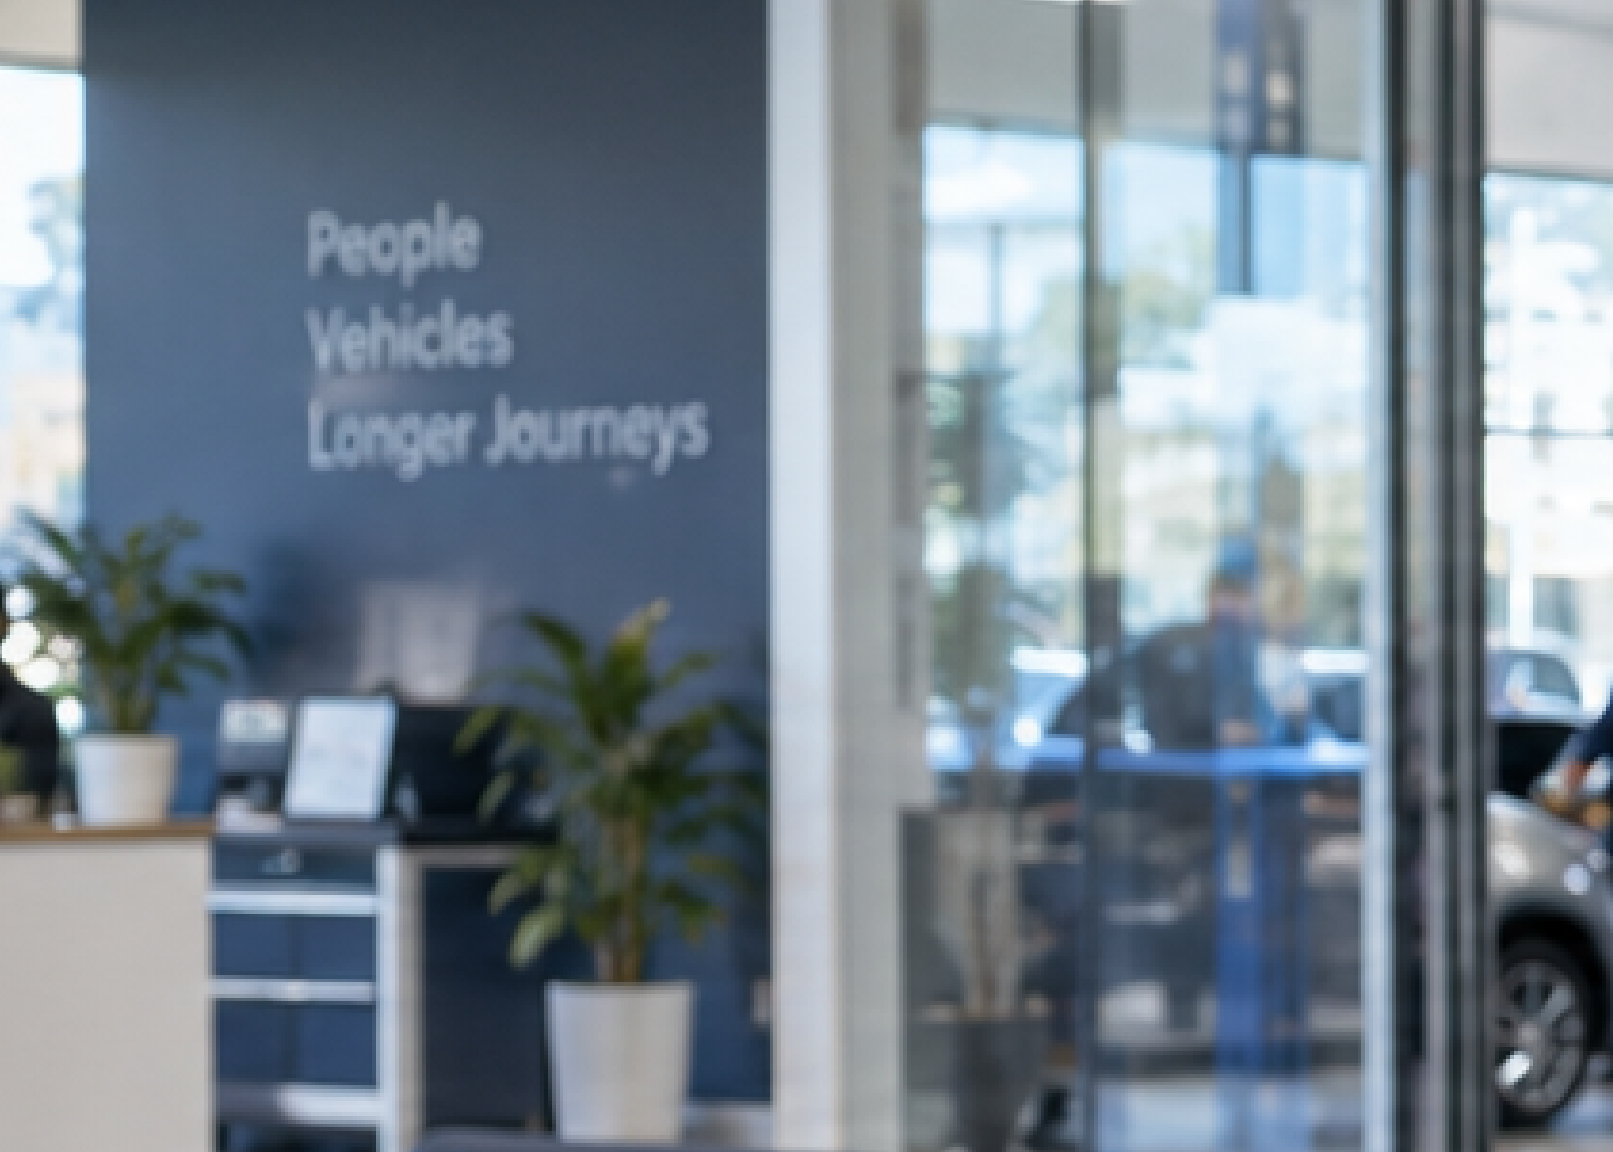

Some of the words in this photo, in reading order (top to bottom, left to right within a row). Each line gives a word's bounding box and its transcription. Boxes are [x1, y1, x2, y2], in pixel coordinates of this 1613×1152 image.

[307, 201, 482, 287] People
[306, 298, 513, 372] Vehicles
[308, 400, 476, 483] Longer
[485, 394, 709, 477] Journeys
